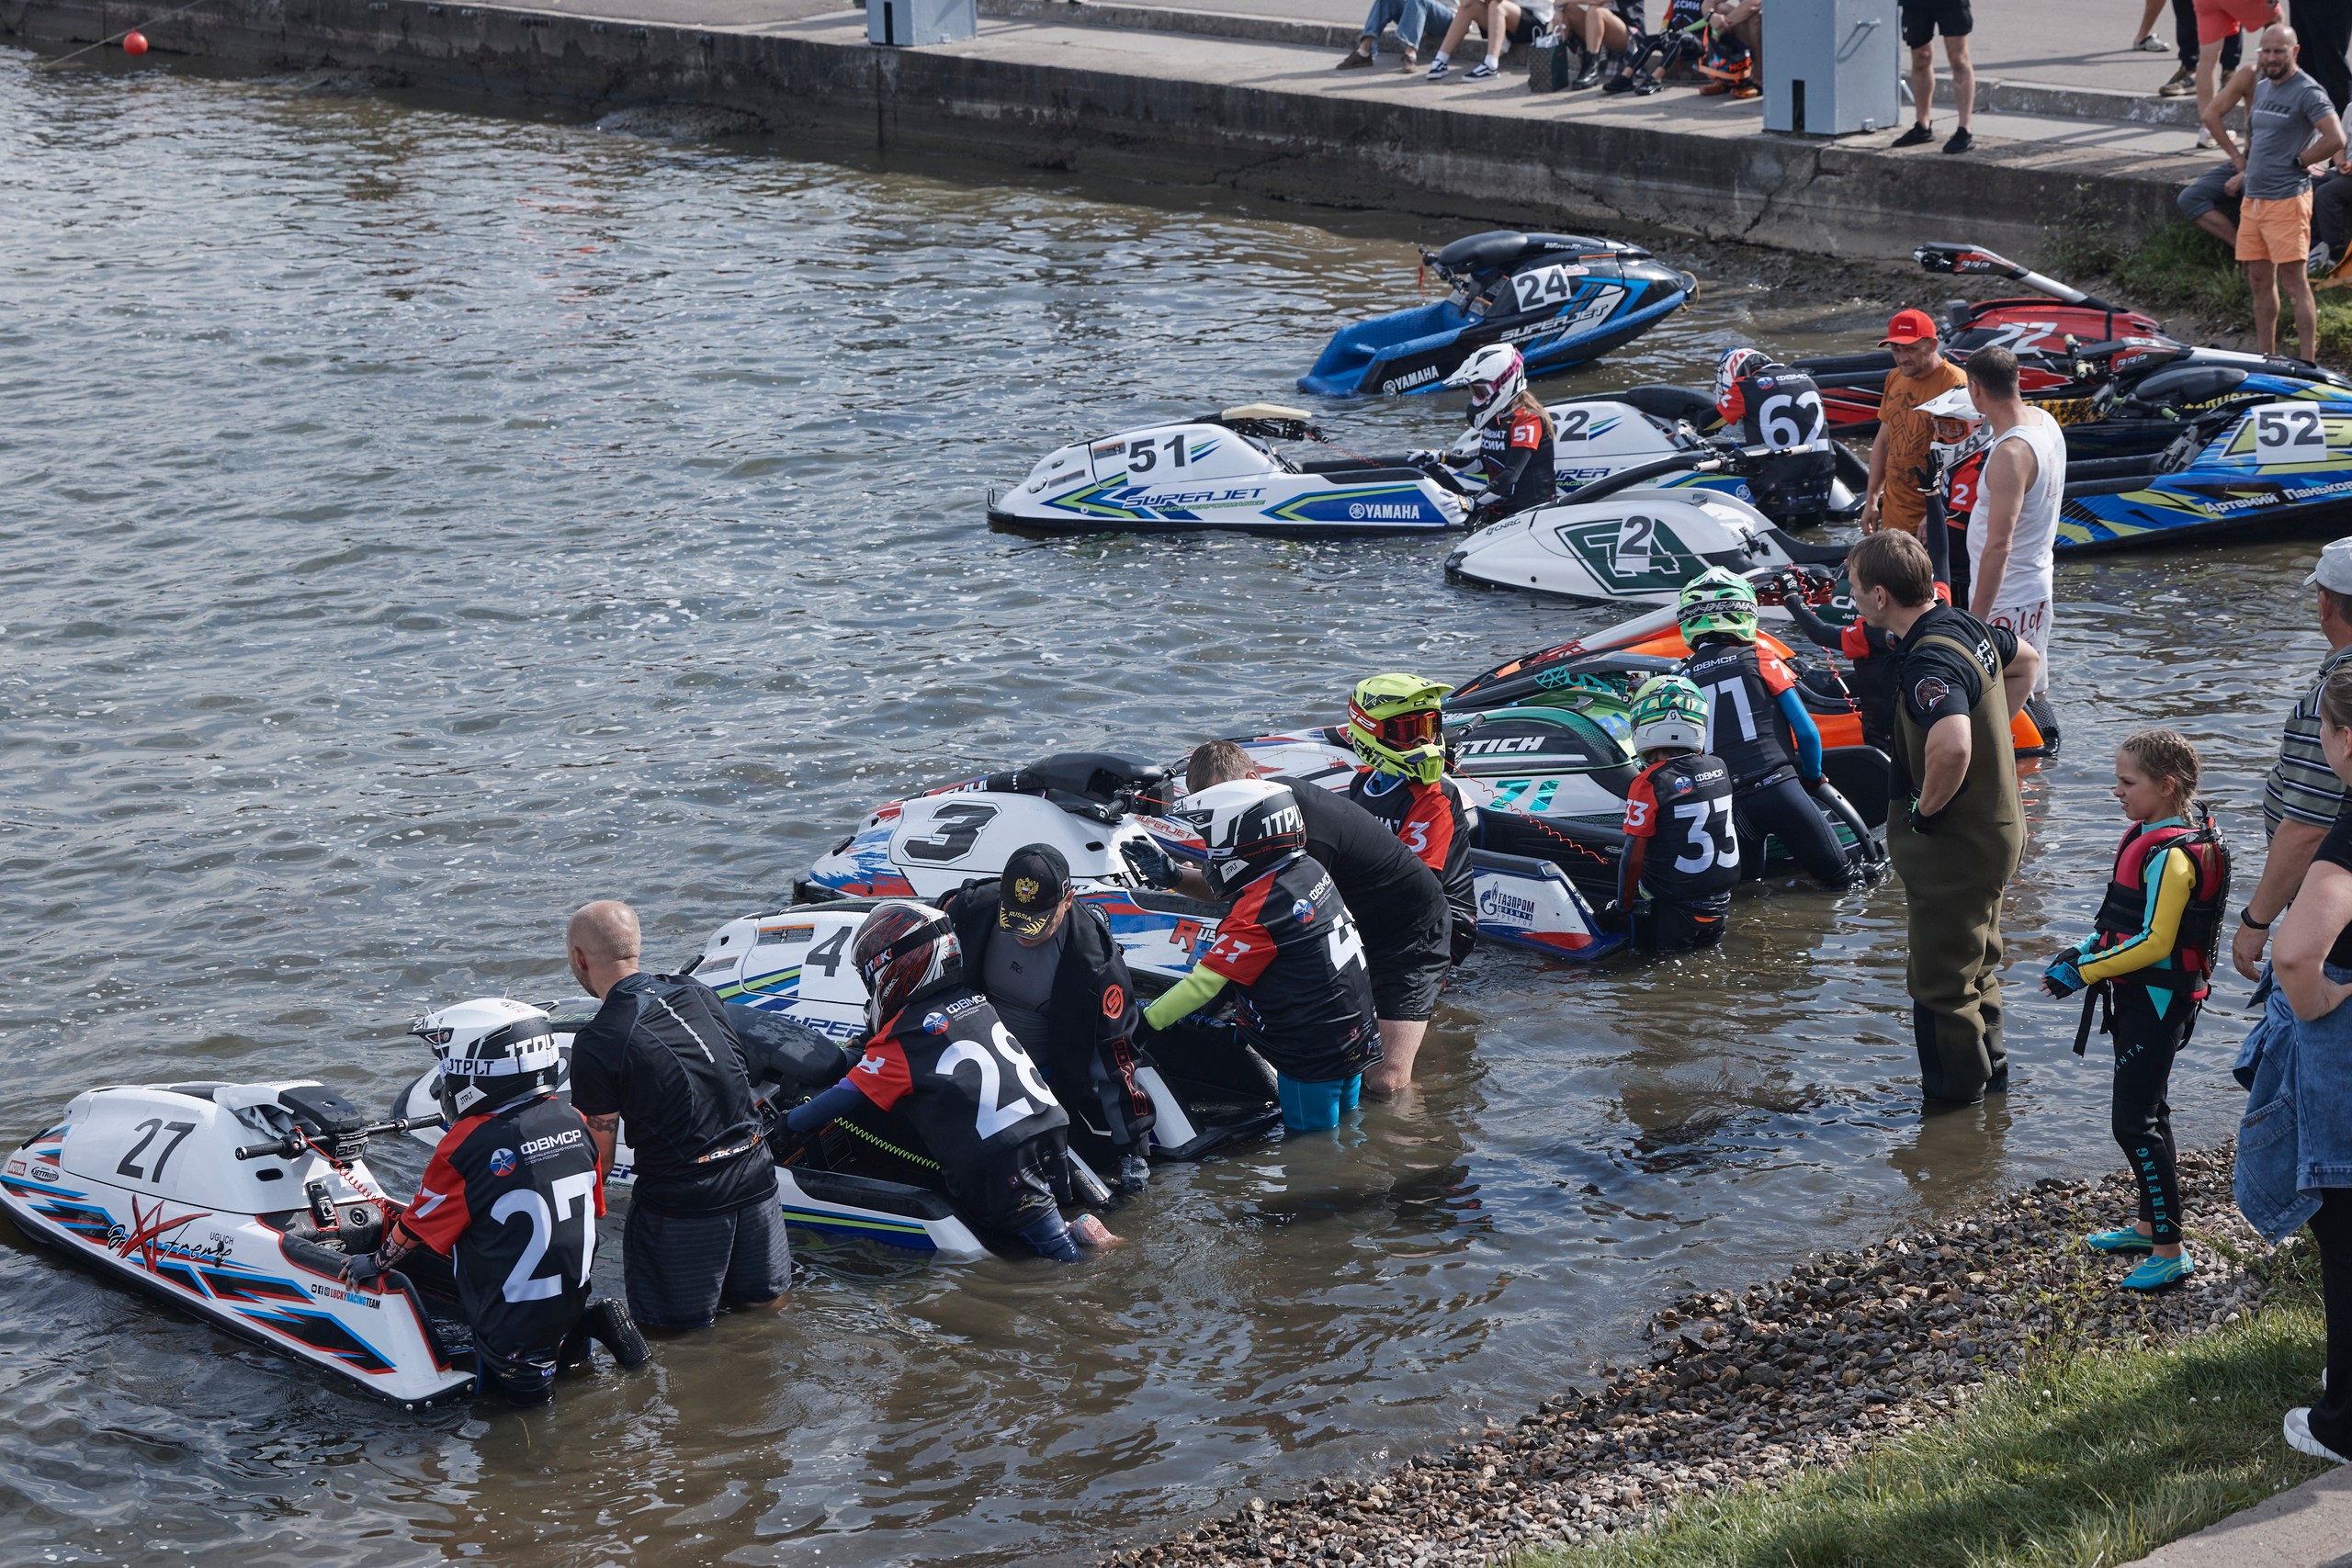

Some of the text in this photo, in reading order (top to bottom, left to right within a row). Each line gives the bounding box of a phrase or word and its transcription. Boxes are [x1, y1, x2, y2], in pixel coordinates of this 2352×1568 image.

[1517, 268, 1567, 309] 24
[1499, 304, 1608, 342] SUPERJET
[1395, 366, 1440, 390] YAMAHA
[1775, 373, 1810, 382] ФВМС
[1513, 424, 1534, 444] 51
[1759, 390, 1830, 452] 62
[2258, 412, 2324, 447] 52
[1127, 434, 1186, 473] 51
[1481, 439, 1506, 451] ССИИ
[1124, 487, 1267, 508] SUPERJET
[1155, 500, 1267, 513] RACE PERFORMANCE
[1952, 483, 1970, 505] 2
[2206, 492, 2279, 514] Артемий
[1366, 504, 1419, 520] YAMAHA
[1619, 515, 1653, 556] 2
[1692, 654, 1737, 672] ФВМСР
[1462, 736, 1545, 754] TICH
[1694, 769, 1724, 783] ФВМСР
[1487, 779, 1560, 812] 71
[1258, 804, 1304, 840] JTPL
[1623, 798, 1649, 827] 33
[902, 802, 1001, 863] 3
[1134, 814, 1194, 840] SUPERJET
[1408, 821, 1430, 853] 3
[1674, 794, 1741, 874] 33
[1308, 872, 1332, 901] ФВМС
[1009, 910, 1032, 922] RUSSIA
[1498, 892, 1535, 914] ГАЗПРОМ
[805, 926, 854, 977] 4
[447, 1058, 494, 1076] JTPLT
[935, 1021, 1059, 1141] 28
[459, 1091, 474, 1106] JTPLT
[117, 1118, 197, 1184] 27
[520, 1129, 582, 1155] ФВМСР
[8, 1161, 27, 1176] MOTUL
[2135, 1147, 2169, 1233] SURFING
[209, 1231, 235, 1246] UGLICH
[490, 1169, 597, 1303] 27
[330, 1289, 381, 1311] LUCKYRACINGTEAM
